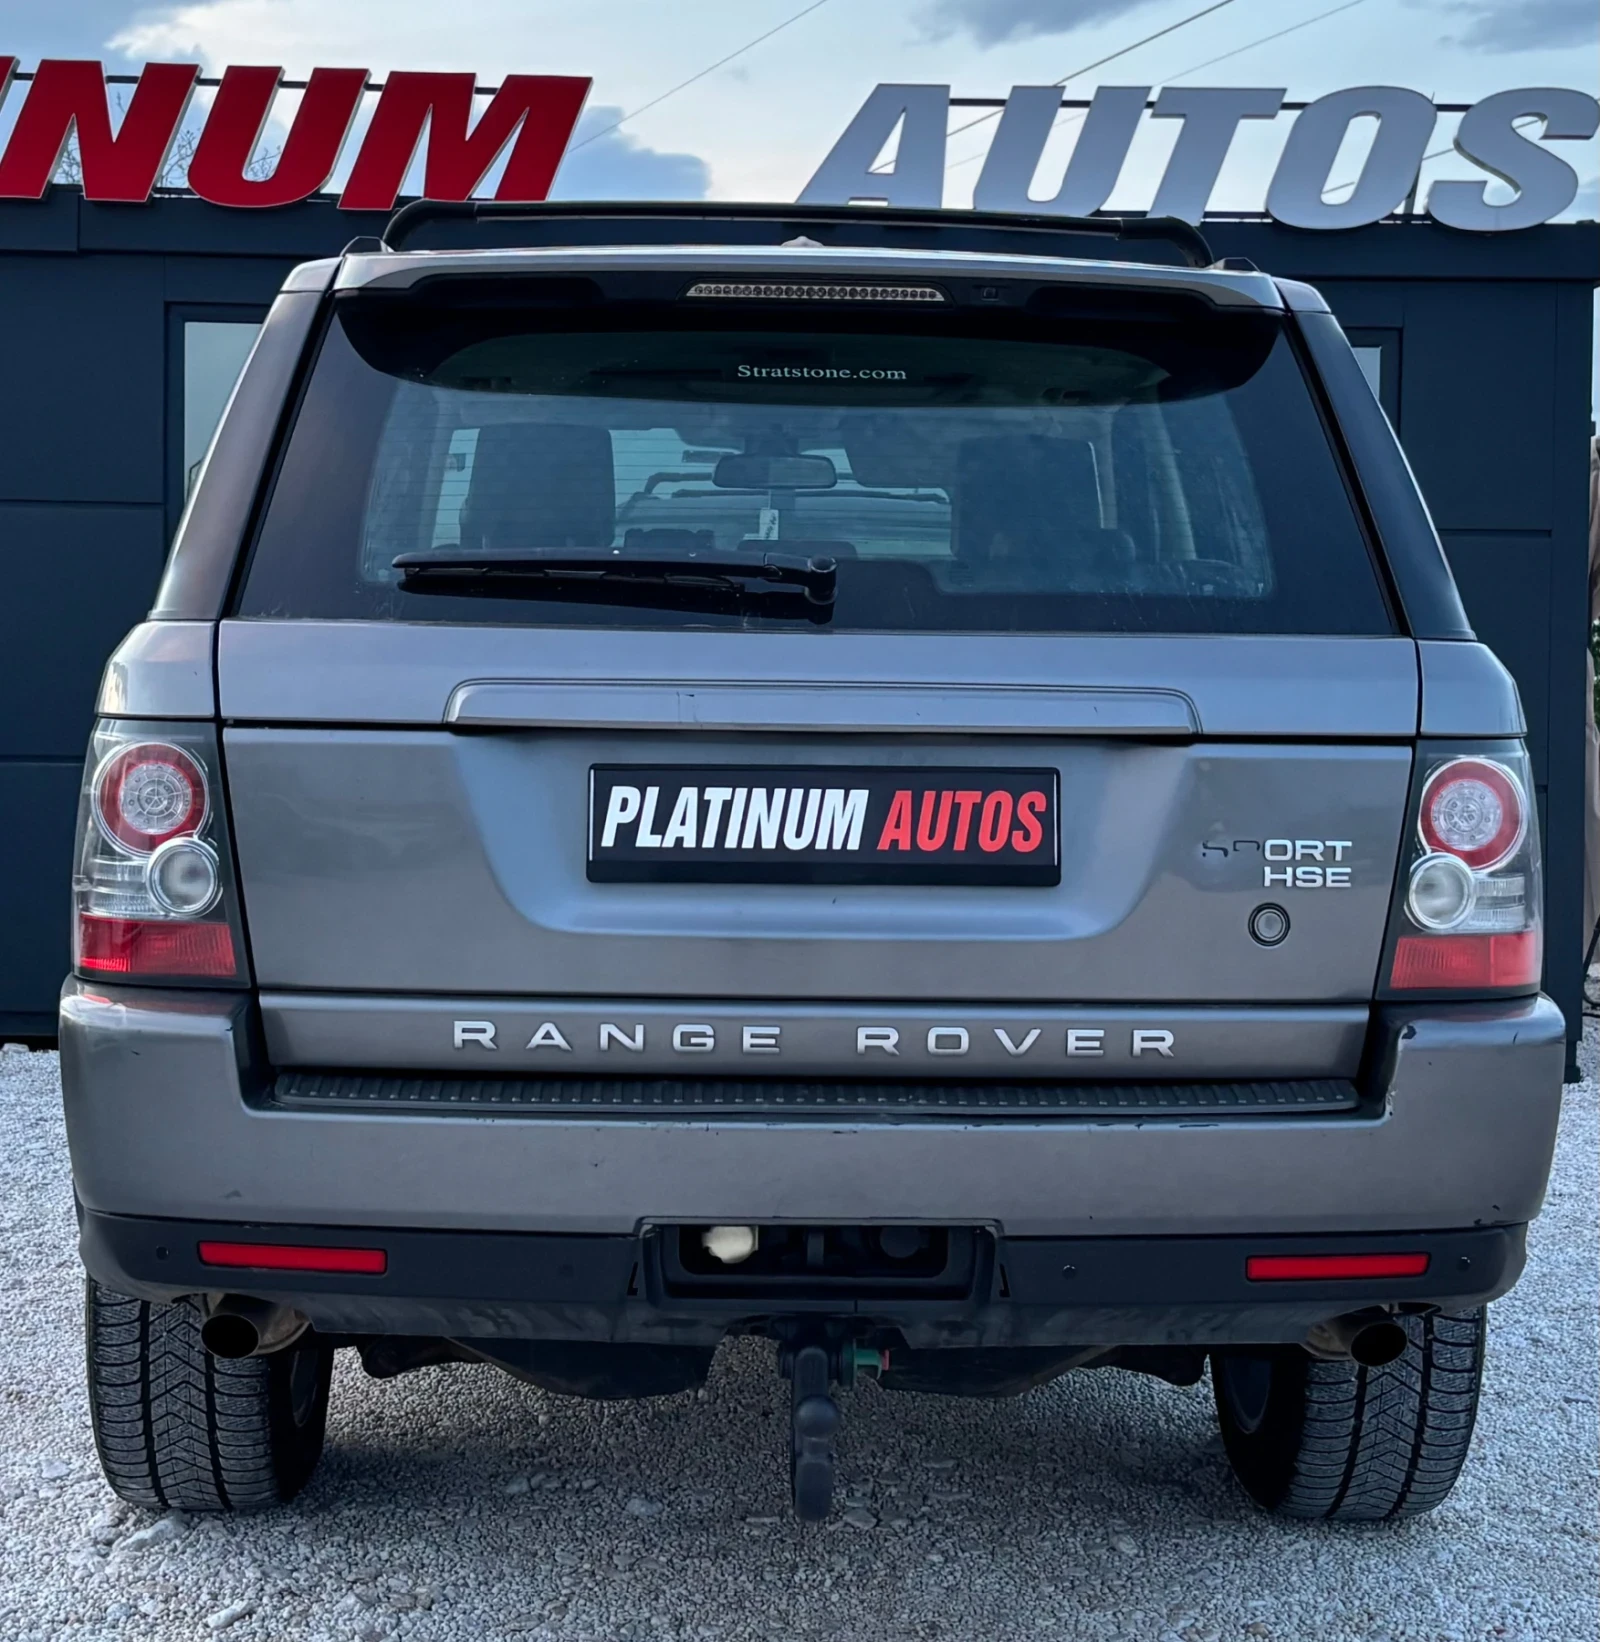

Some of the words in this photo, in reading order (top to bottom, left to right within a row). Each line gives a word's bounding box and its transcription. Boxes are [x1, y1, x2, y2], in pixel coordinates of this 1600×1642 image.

[0, 56, 593, 210] NUM
[794, 82, 1600, 231] AUTOS
[737, 364, 907, 380] Stratstone.com
[601, 785, 869, 851] PLATINUM
[877, 789, 1047, 853] AUTOS
[1202, 839, 1352, 861] ORT
[1263, 866, 1352, 888] HSE
[452, 1019, 782, 1055] RANGE
[856, 1025, 1176, 1058] ROVER
